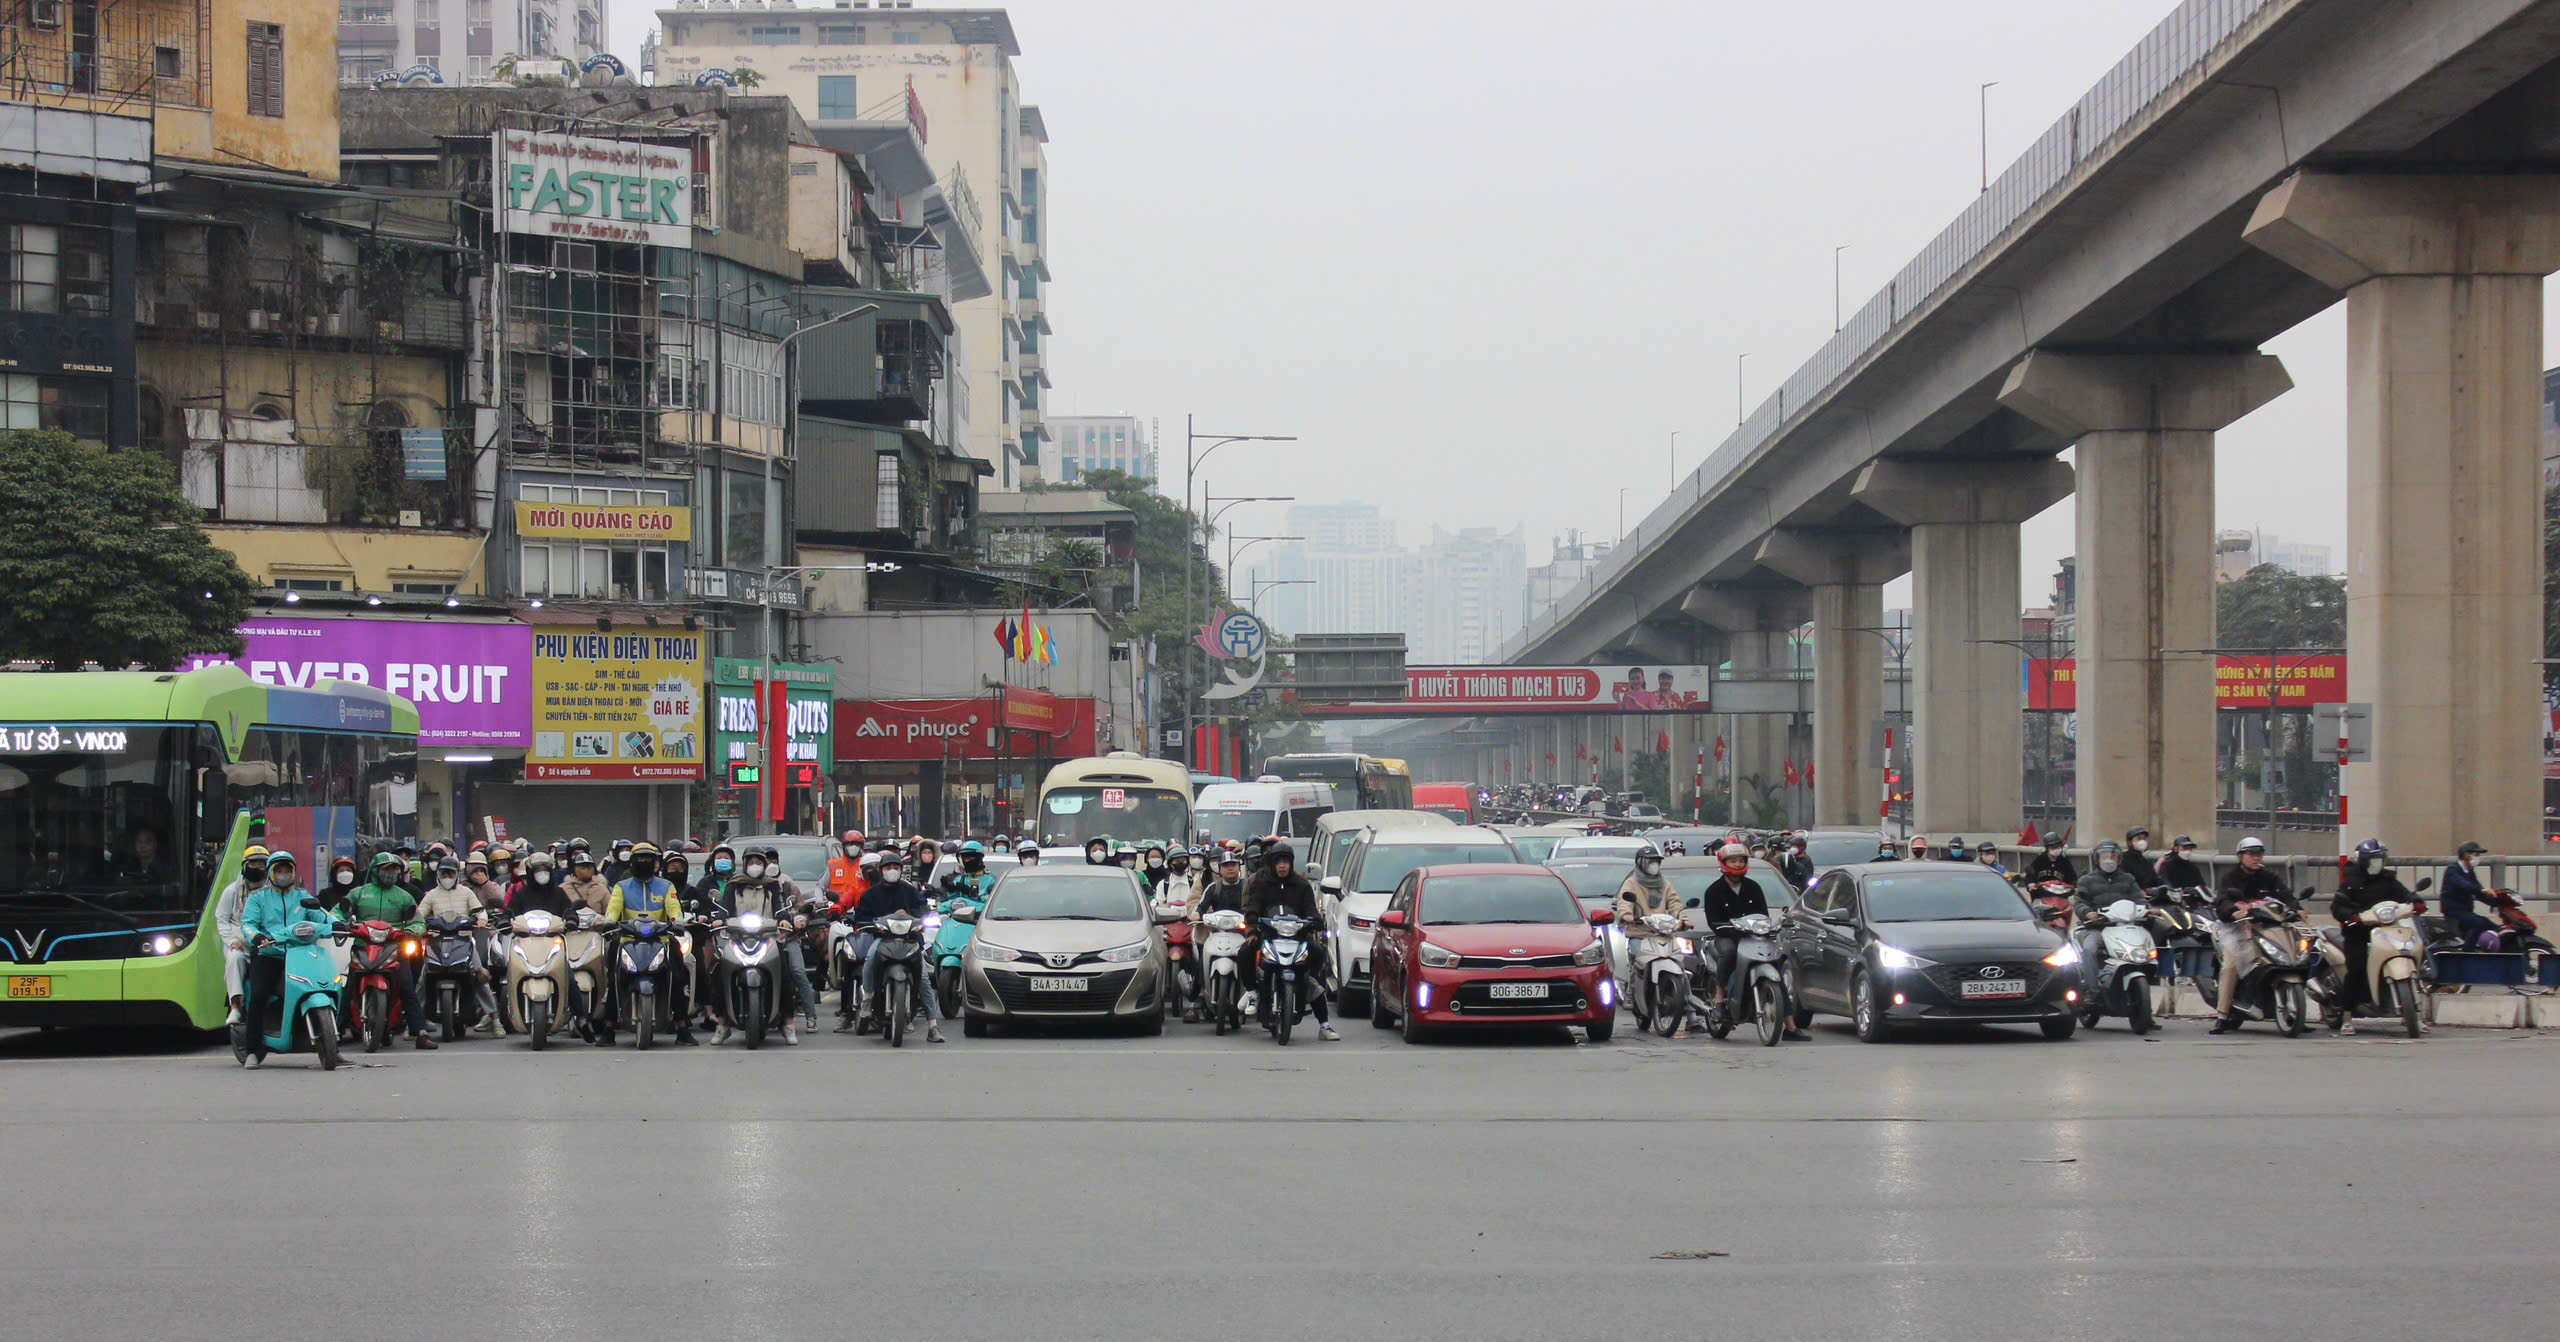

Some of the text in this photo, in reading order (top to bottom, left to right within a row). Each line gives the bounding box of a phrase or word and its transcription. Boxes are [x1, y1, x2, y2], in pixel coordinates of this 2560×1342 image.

[530, 507, 673, 531] MỜI QUẢNG CÁO
[535, 632, 697, 665] PHỤ KIỆN ĐIỆN THOẠI
[595, 670, 607, 679] SIM
[2263, 664, 2292, 681] NỆM
[2294, 667, 2307, 678] 95
[2310, 664, 2336, 679] NĂM
[386, 663, 508, 703] FRUIT
[546, 682, 559, 691] USB
[622, 683, 631, 691] TAI
[1419, 670, 1459, 698] HUYẾT
[1463, 673, 1507, 698] THÔNG
[1512, 676, 1552, 701] MẠCH
[1556, 676, 1586, 697] TW3
[2281, 685, 2305, 697] NAM
[546, 697, 560, 706] MUA
[653, 696, 689, 715] GIÁ RẺ
[624, 712, 638, 721] 24/7
[719, 696, 828, 740] FRES RUITS
[14, 729, 34, 751] TƯ
[37, 726, 60, 751] SỞ
[730, 742, 745, 759] HOA
[650, 892, 664, 904] be
[20, 978, 39, 986] 29F
[1033, 979, 1087, 991] 34A-314.47
[1492, 985, 1547, 997] 30G-386.71
